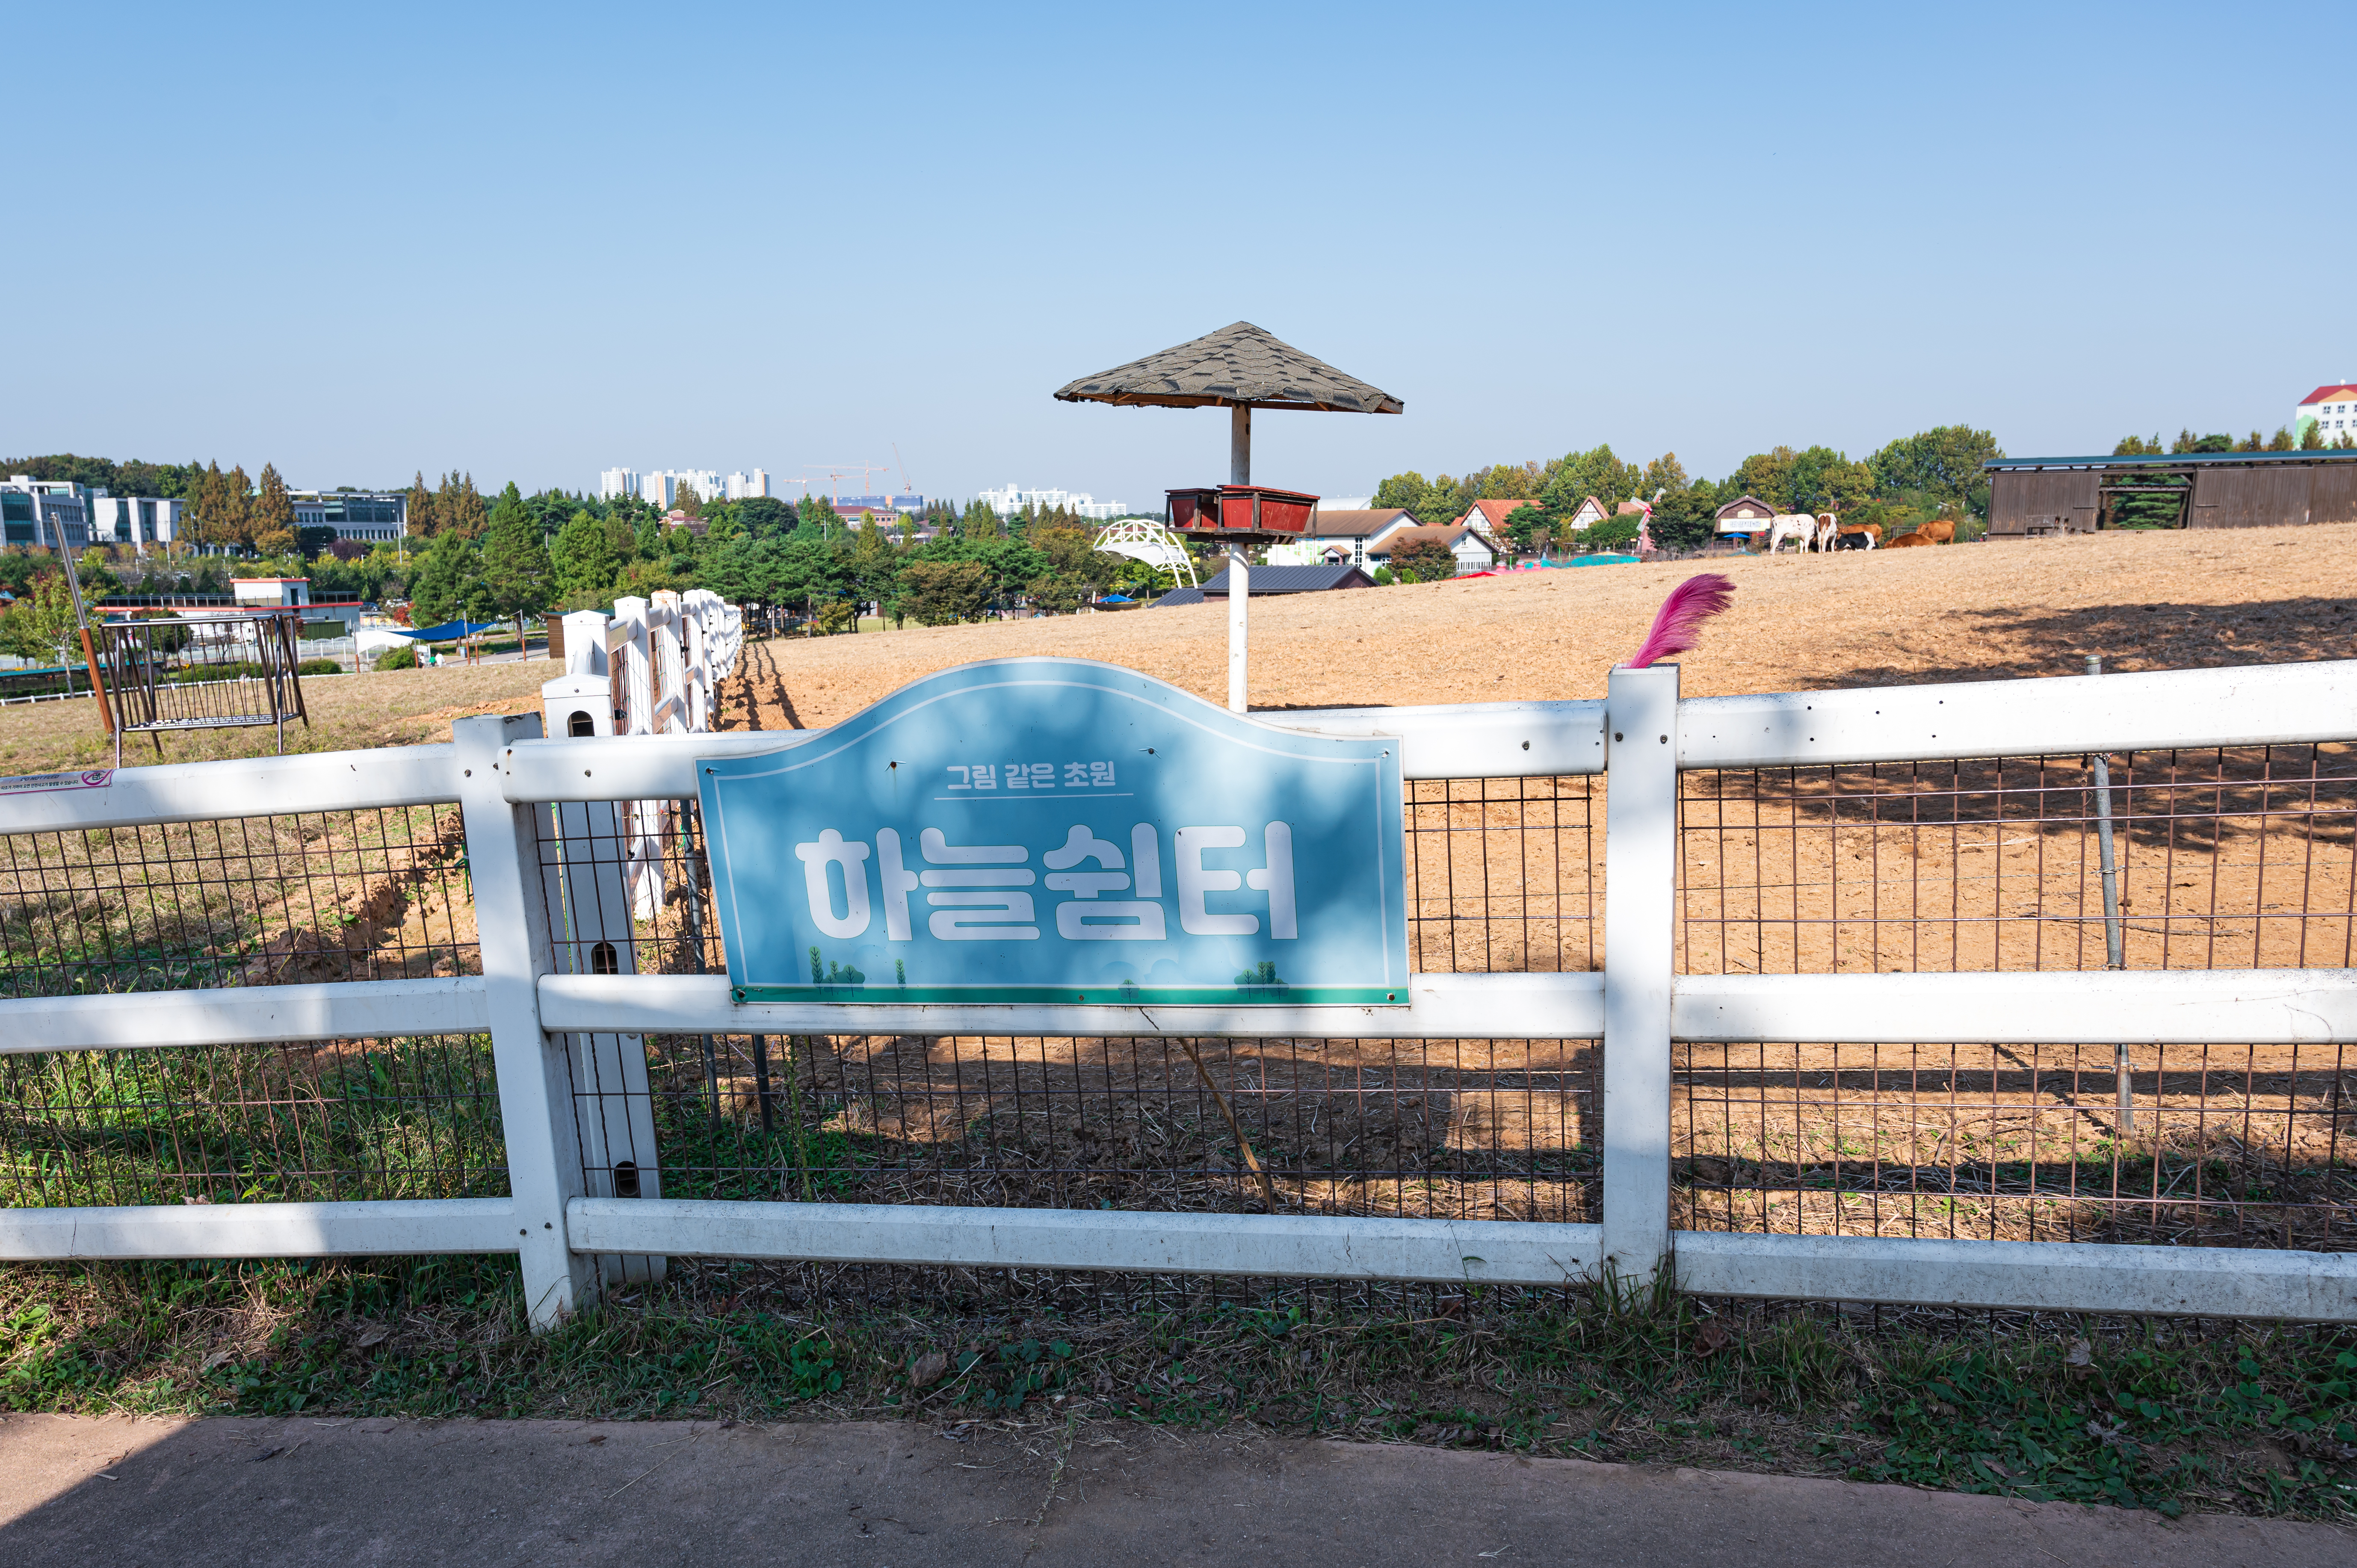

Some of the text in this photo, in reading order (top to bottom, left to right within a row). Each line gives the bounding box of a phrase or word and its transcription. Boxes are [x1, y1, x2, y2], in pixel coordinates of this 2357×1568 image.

[946, 761, 1116, 789] 그림 같은 초원
[795, 820, 1298, 941] 하늘쉼터
